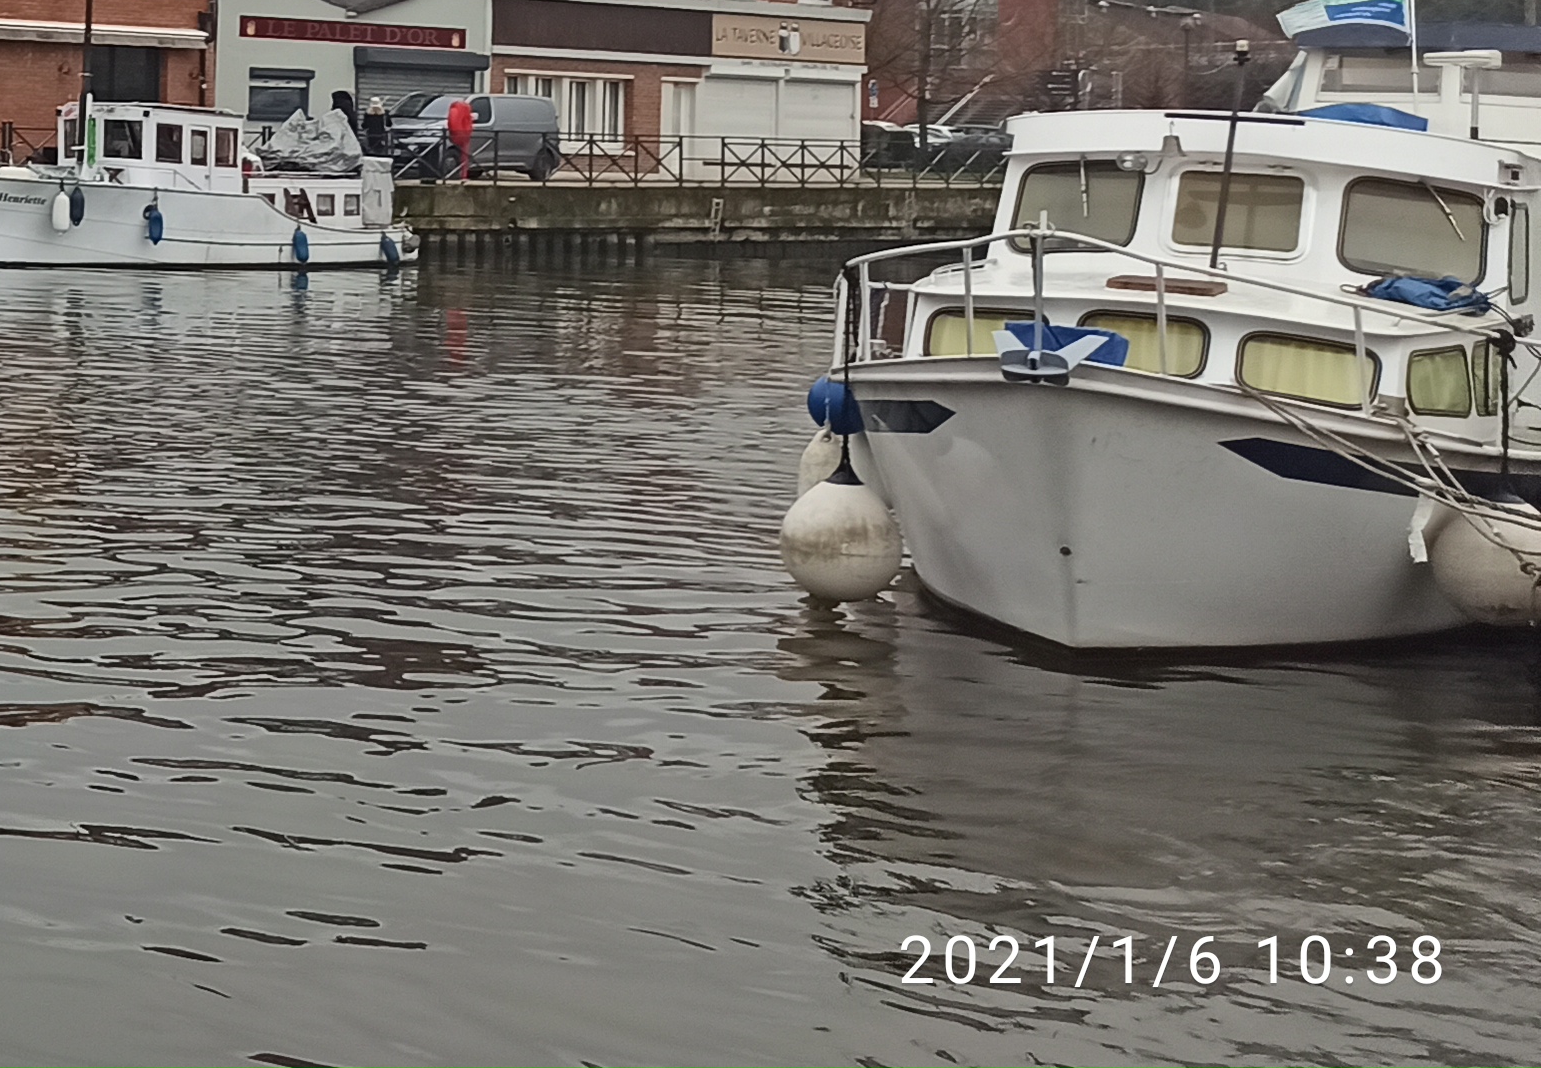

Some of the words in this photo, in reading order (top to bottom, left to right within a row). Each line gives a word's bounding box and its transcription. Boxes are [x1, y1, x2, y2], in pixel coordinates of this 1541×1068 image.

[266, 20, 295, 37] LE
[305, 23, 378, 42] PALET
[384, 29, 440, 45] D'OR
[716, 28, 727, 42] LA
[731, 28, 776, 45] TAVERNE
